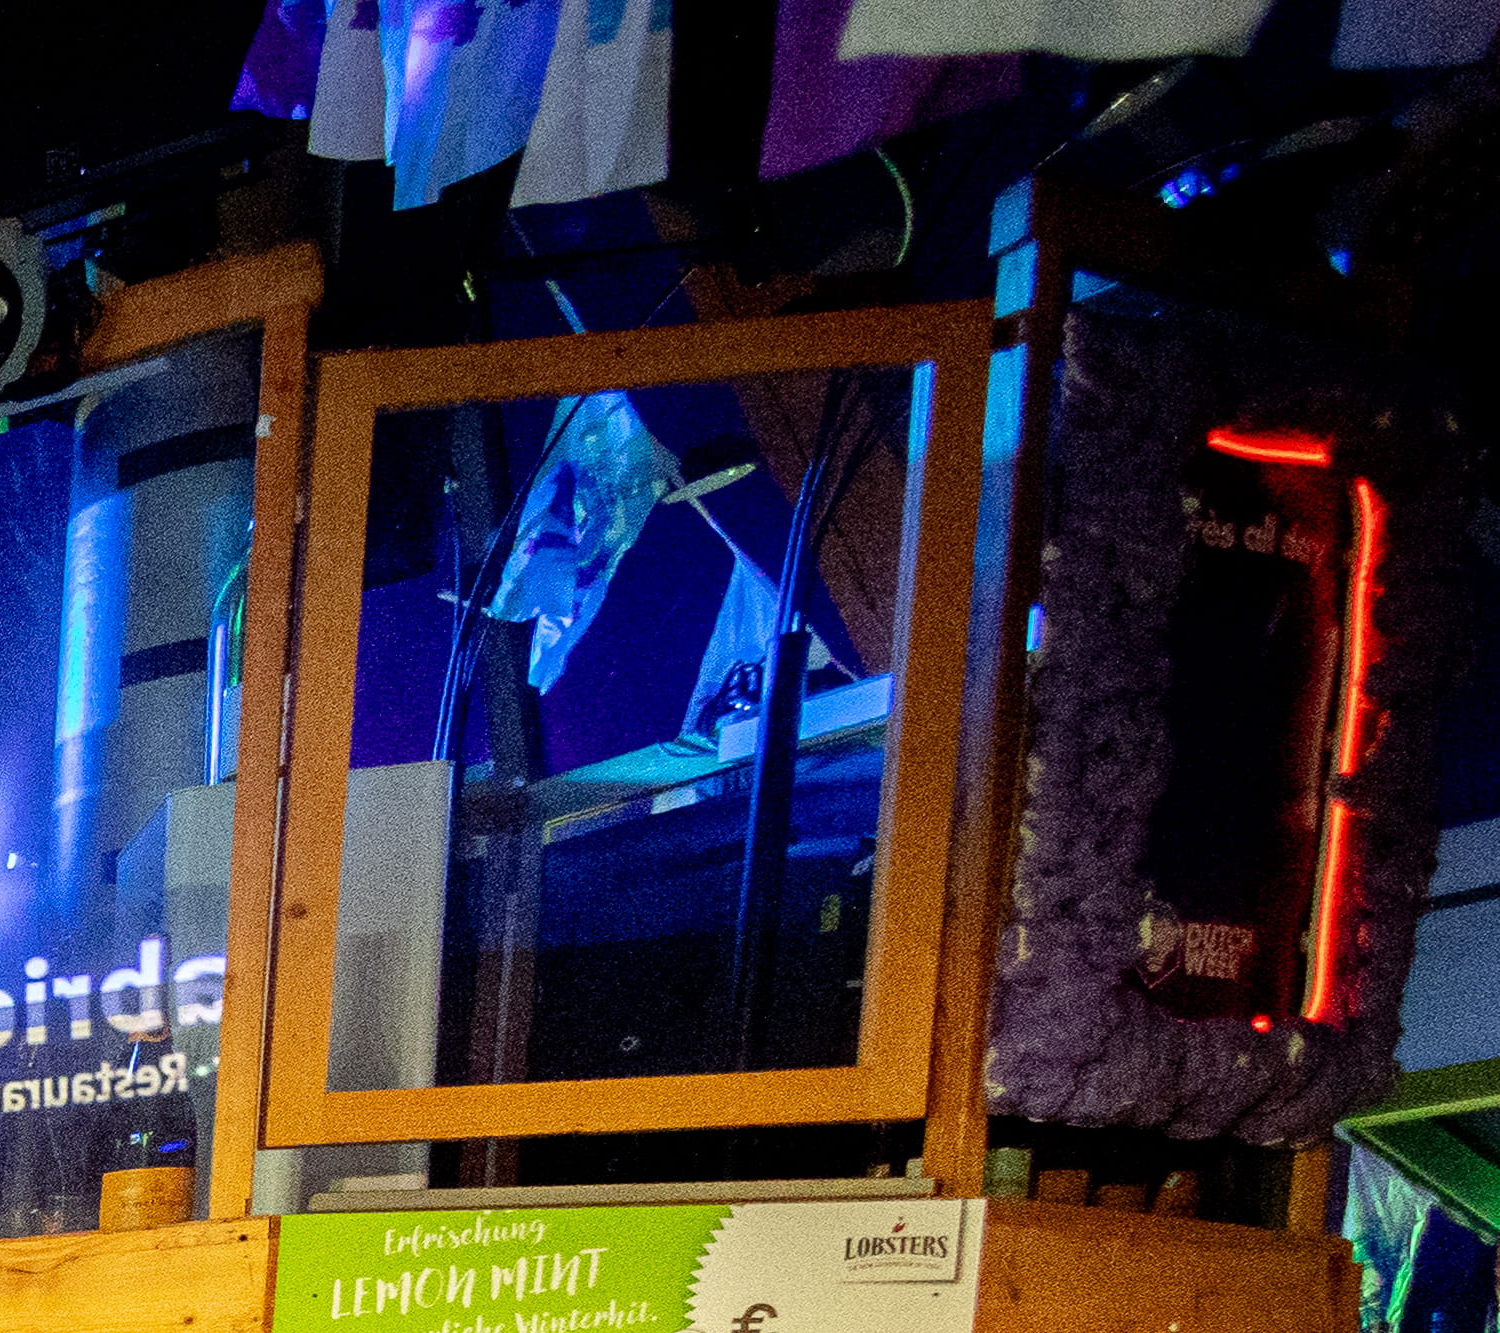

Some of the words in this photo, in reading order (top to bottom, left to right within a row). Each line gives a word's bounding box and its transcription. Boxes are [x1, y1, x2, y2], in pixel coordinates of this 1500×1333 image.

[383, 1215, 549, 1256] Erfrischung
[843, 1235, 949, 1261] LOBSTERS
[331, 1263, 477, 1320] LEMON
[489, 1246, 610, 1304] MINT
